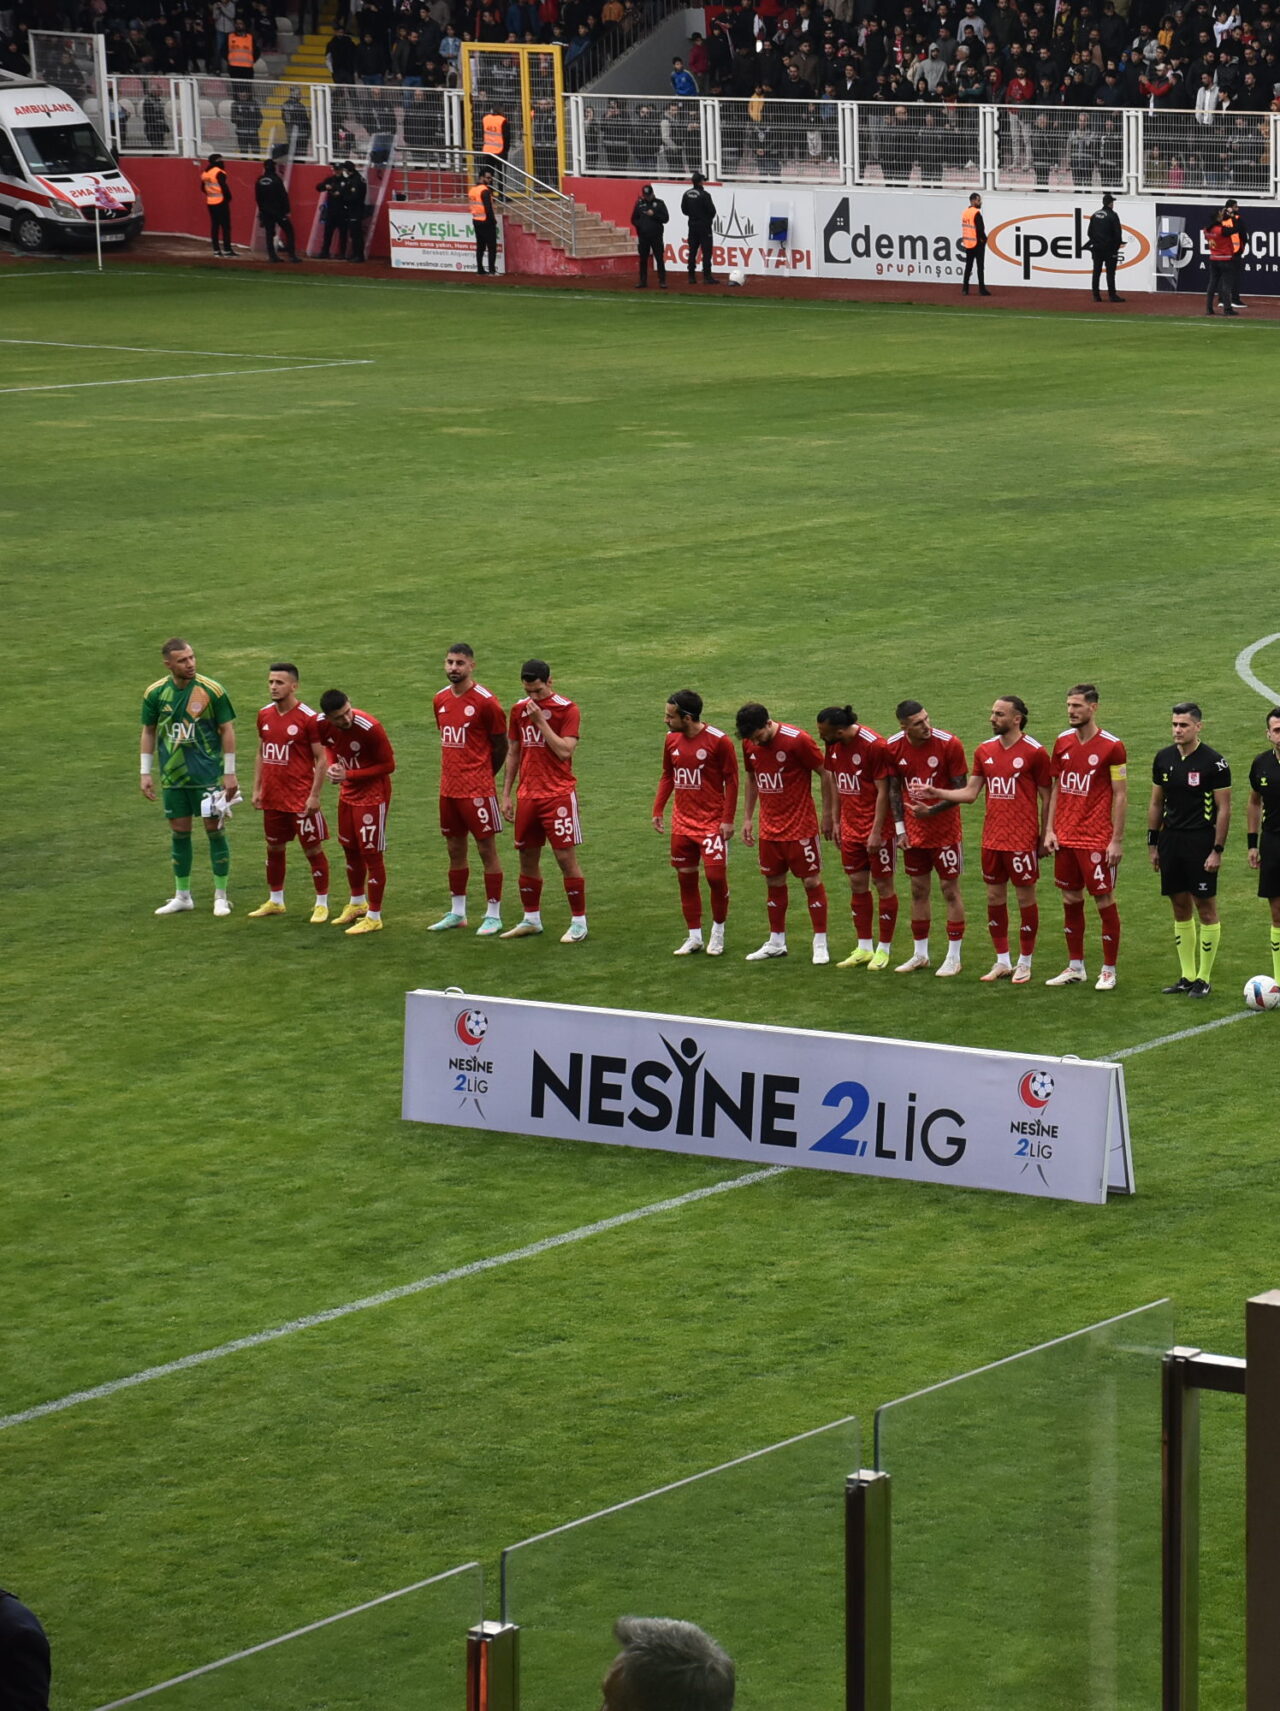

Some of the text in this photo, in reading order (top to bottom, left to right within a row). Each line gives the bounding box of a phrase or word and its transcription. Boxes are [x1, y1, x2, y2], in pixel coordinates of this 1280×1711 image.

[14, 103, 75, 116] AMBULANS
[758, 247, 811, 270] YAPI
[477, 807, 489, 824] 9
[297, 820, 315, 836] 74
[359, 825, 377, 842] 17
[554, 818, 573, 836] 55
[702, 836, 723, 854] 24
[804, 846, 816, 863] 5
[879, 849, 890, 865] 8
[939, 850, 958, 867] 19
[1012, 855, 1032, 873] 61
[1093, 865, 1105, 882] 4
